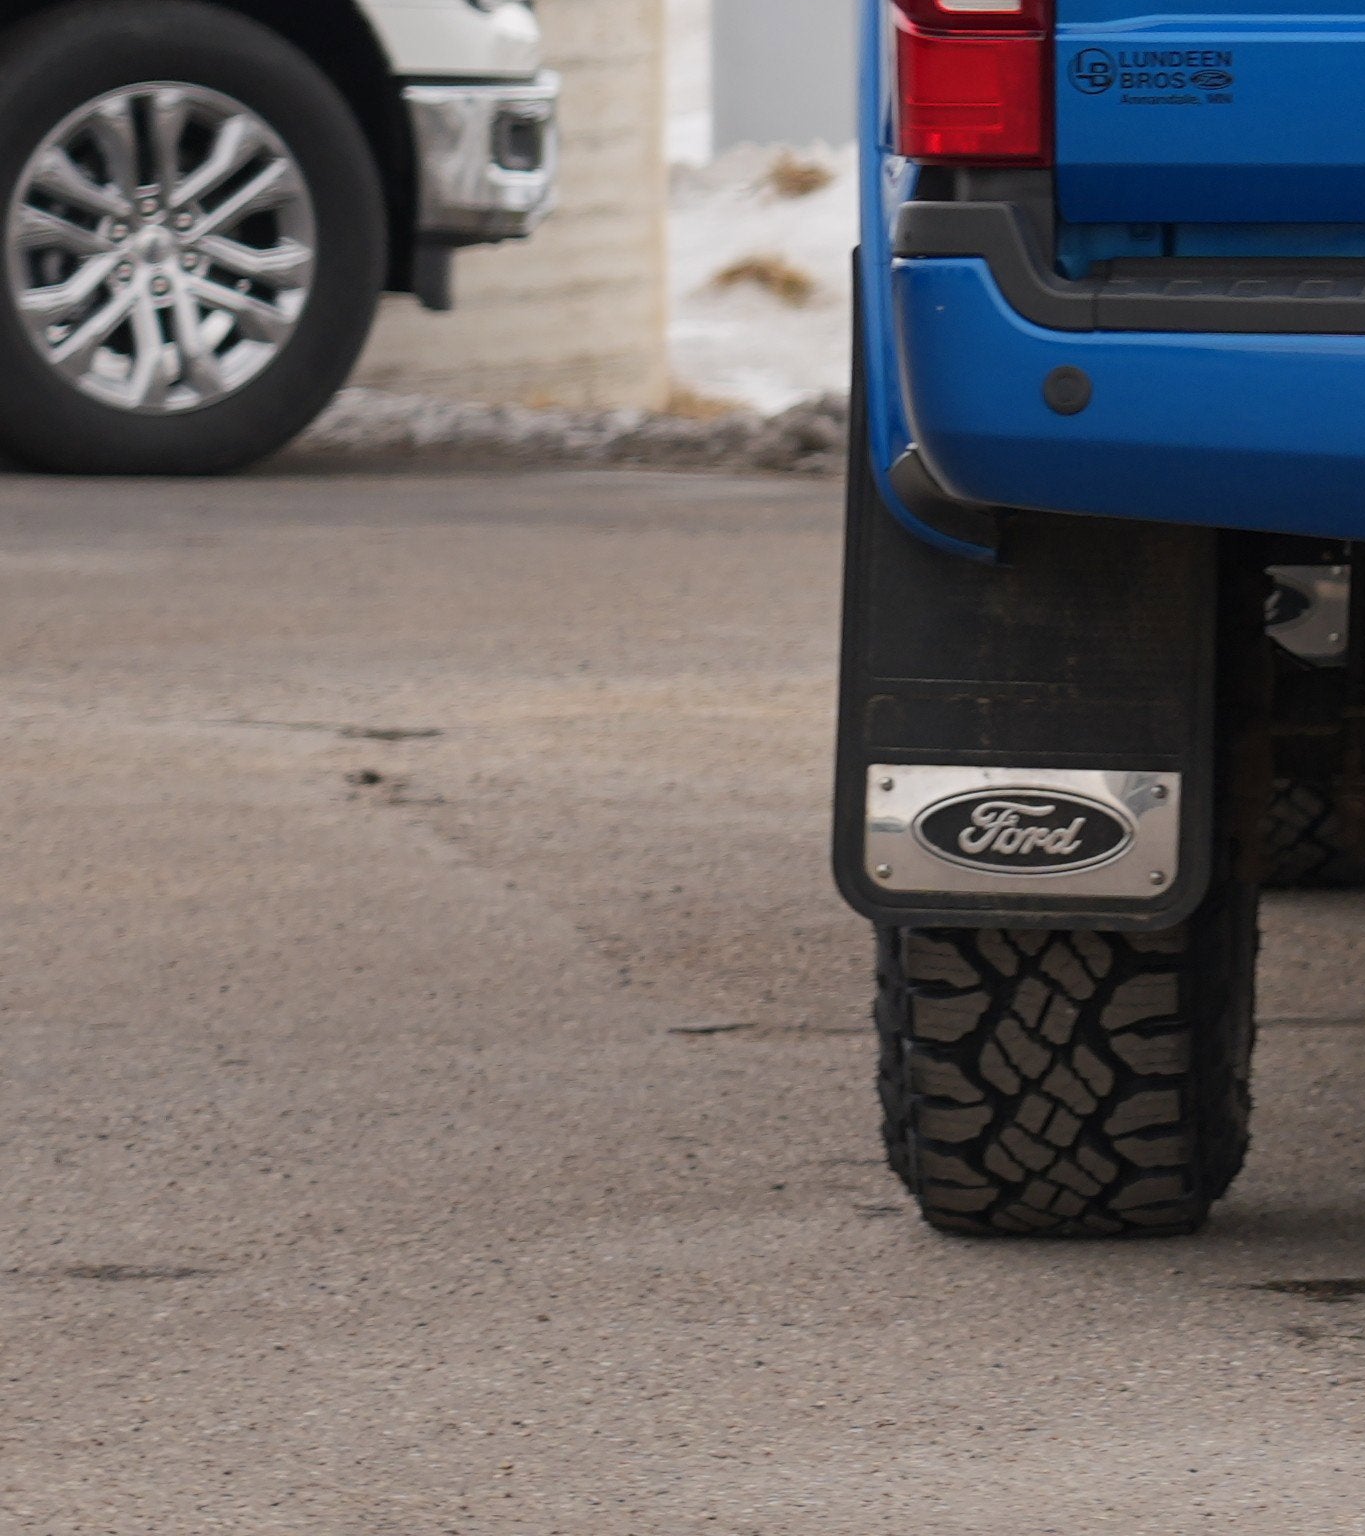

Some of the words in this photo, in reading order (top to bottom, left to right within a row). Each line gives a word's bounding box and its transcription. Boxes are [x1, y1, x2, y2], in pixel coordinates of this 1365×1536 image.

[1118, 50, 1234, 68] LUNDEEN
[1119, 71, 1187, 89] BROS
[958, 800, 1088, 856] Ford
